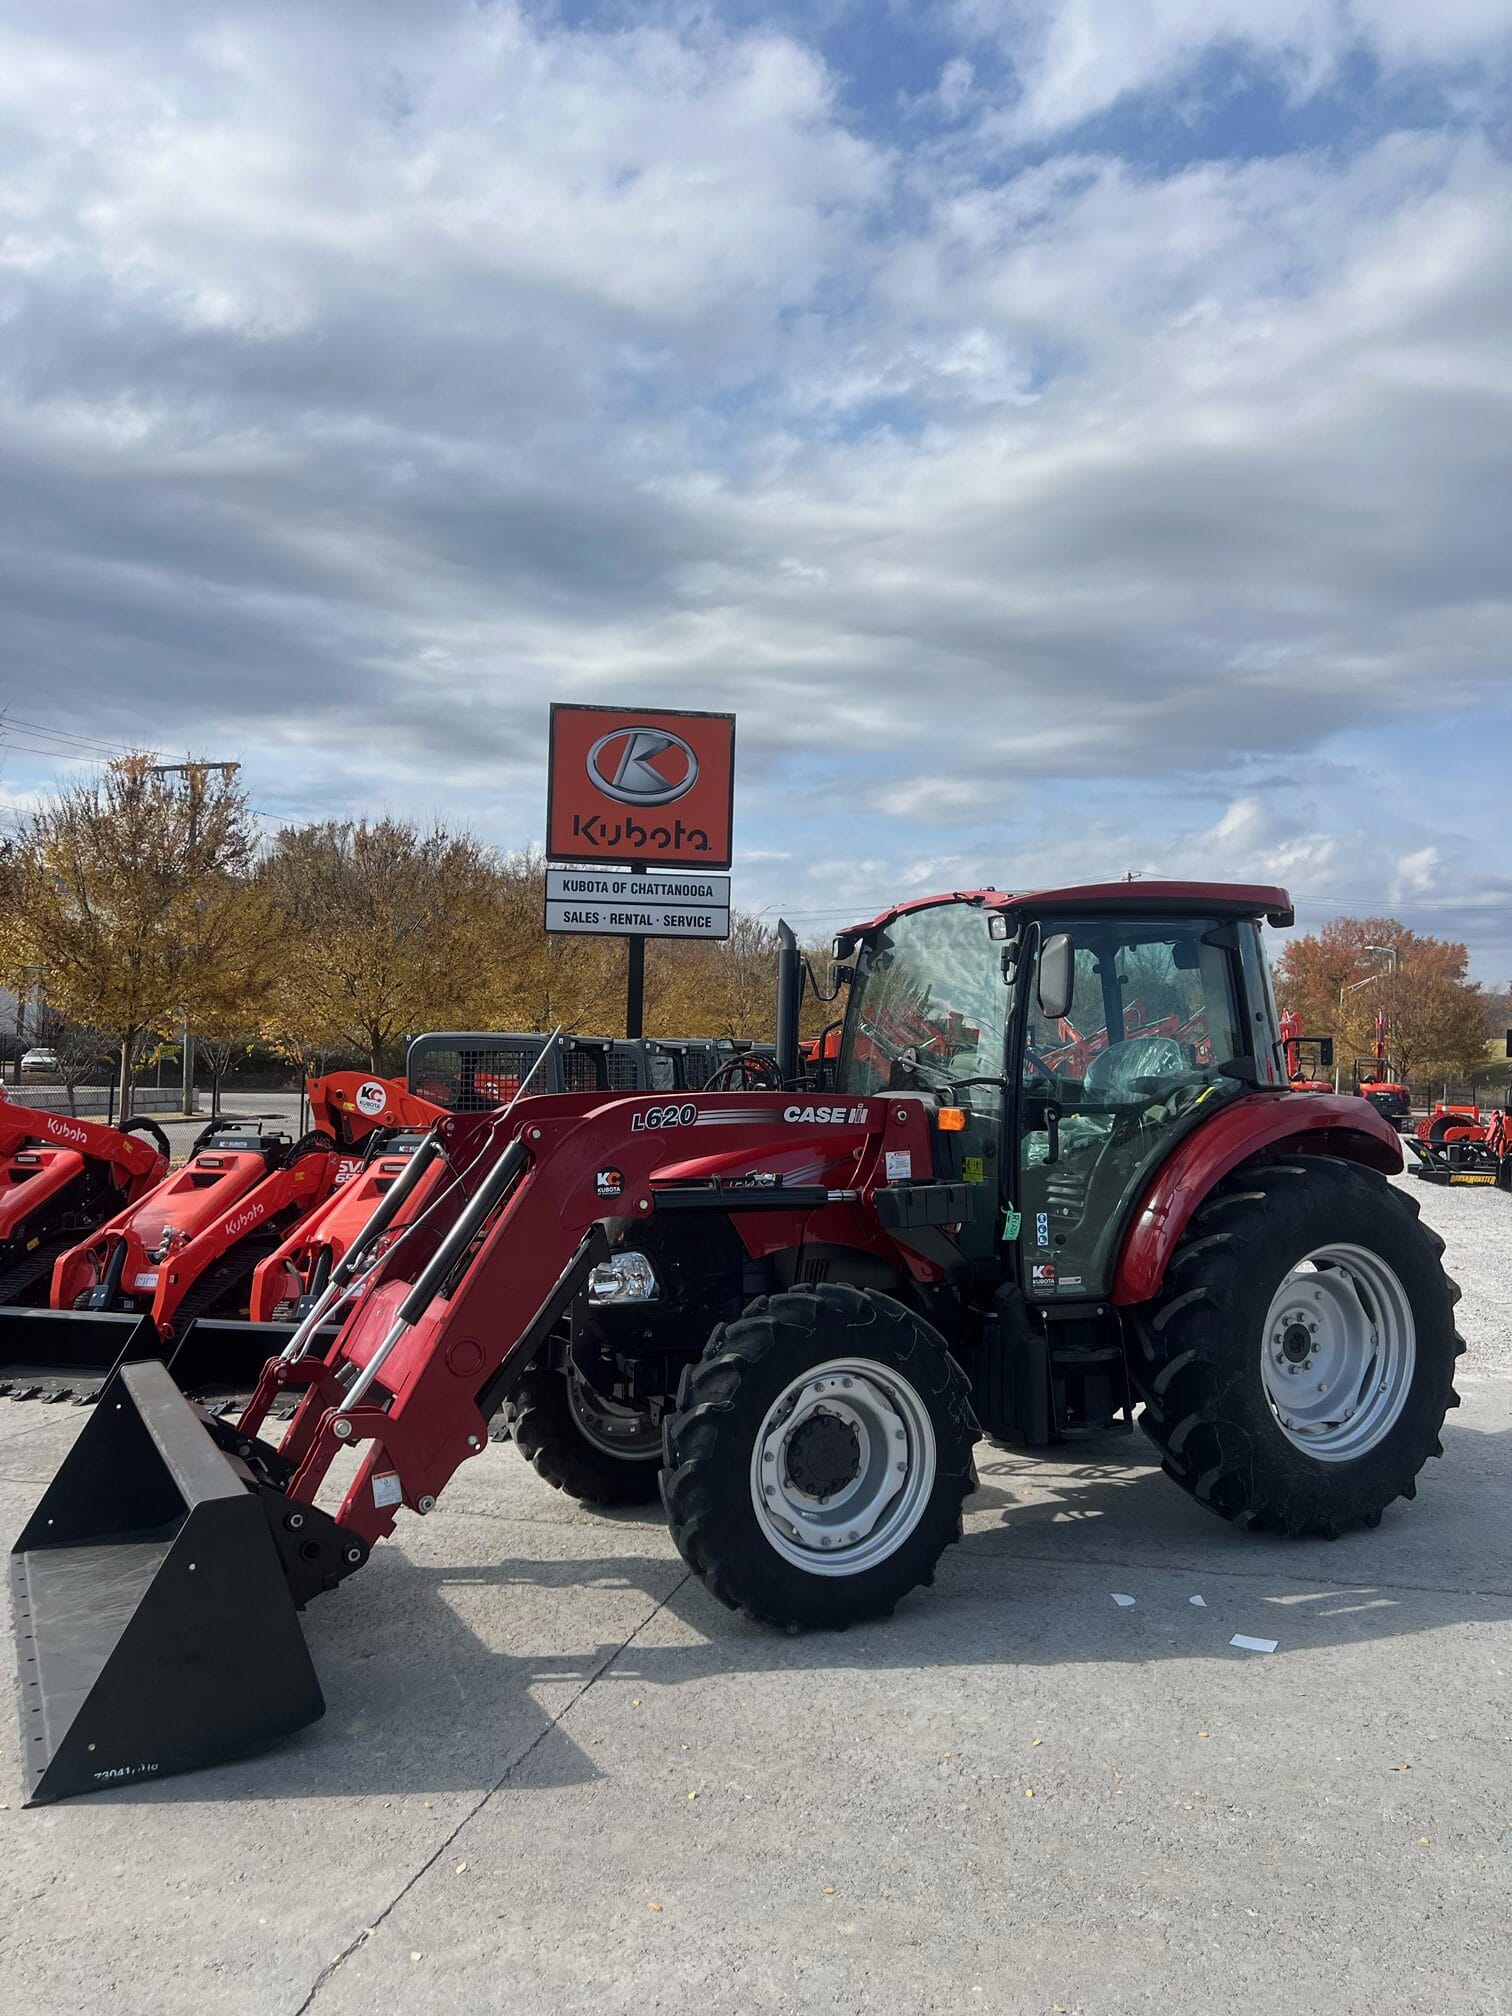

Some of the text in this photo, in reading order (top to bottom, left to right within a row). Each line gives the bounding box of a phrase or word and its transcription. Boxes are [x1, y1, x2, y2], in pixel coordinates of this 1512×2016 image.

[573, 815, 708, 850] Kubota
[562, 880, 714, 898] KUBOTA OF CHATTANOOGA
[563, 911, 712, 928] SALES RENTAL SERVICE
[631, 1103, 697, 1132] L620
[784, 1106, 847, 1124] CASE
[47, 1118, 87, 1143] Kubota
[225, 1204, 264, 1234] Kubota
